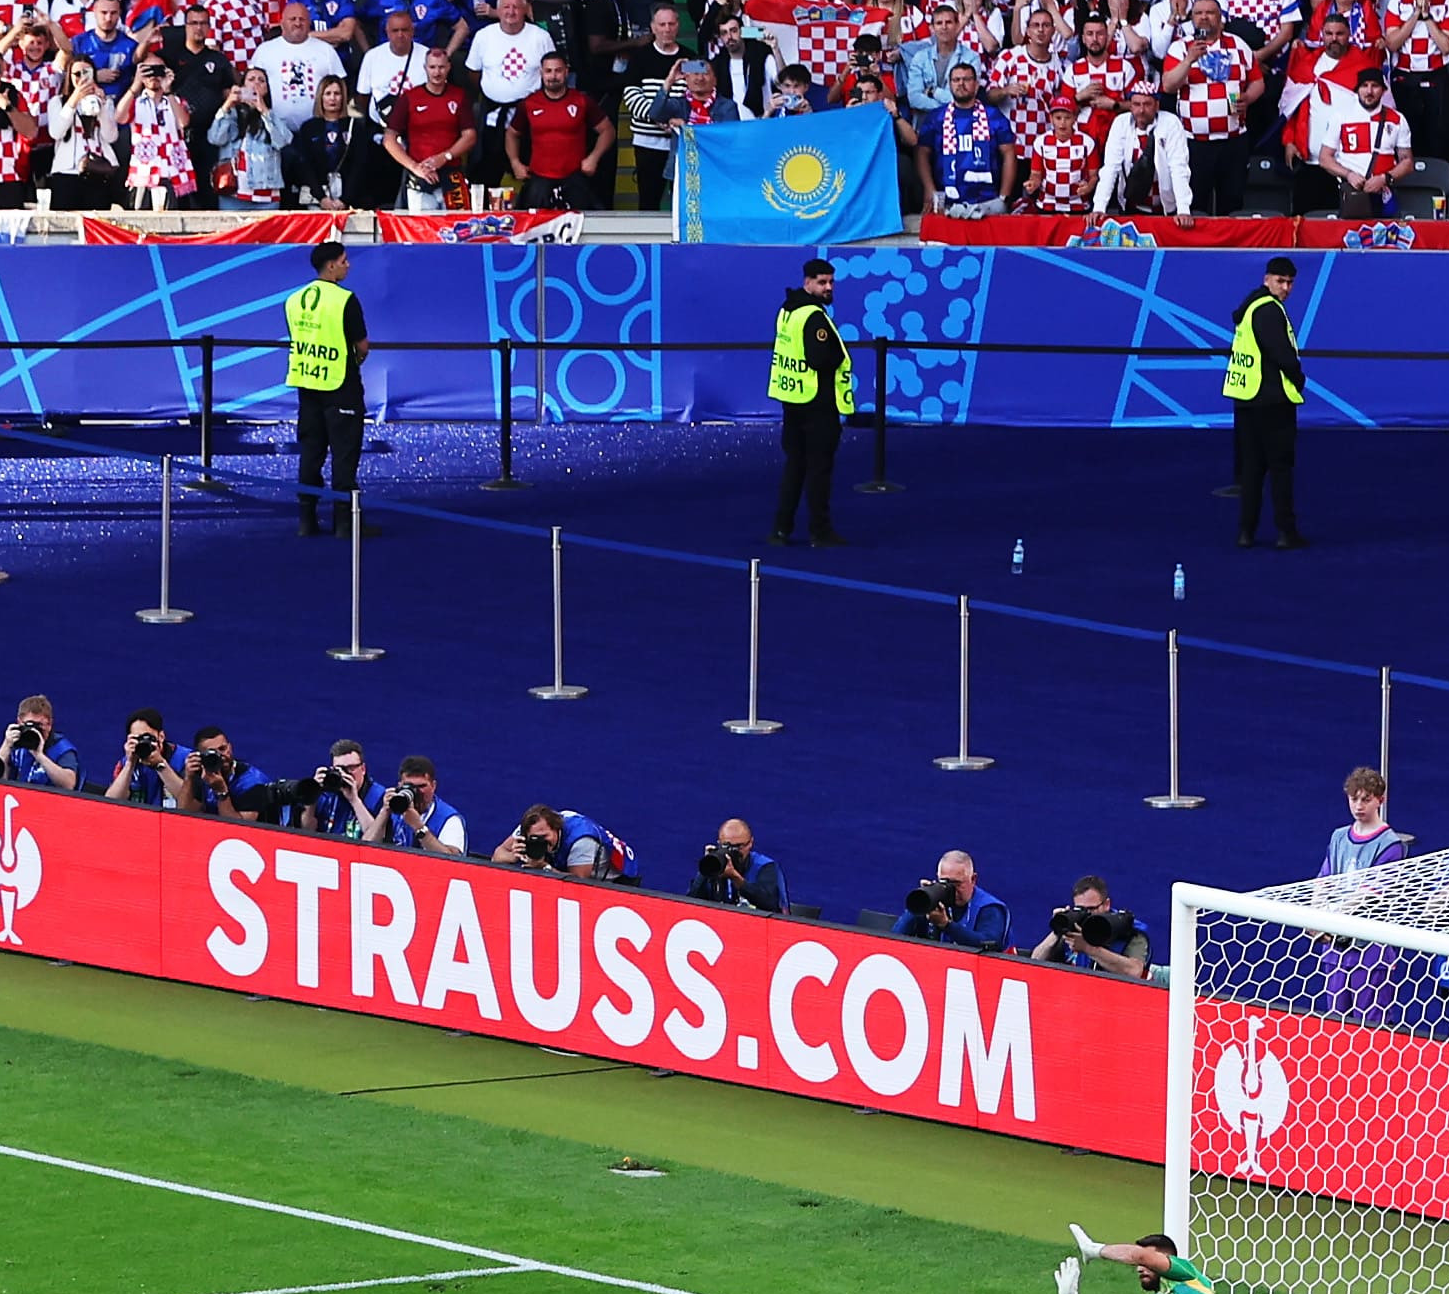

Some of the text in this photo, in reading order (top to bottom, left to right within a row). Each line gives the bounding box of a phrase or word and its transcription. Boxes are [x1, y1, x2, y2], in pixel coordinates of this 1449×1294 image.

[958, 134, 972, 152] 10
[1348, 134, 1357, 150] 9
[288, 340, 339, 360] EWARD
[771, 352, 808, 373] EWARD
[205, 838, 1038, 1122] STRAUSS.COM
